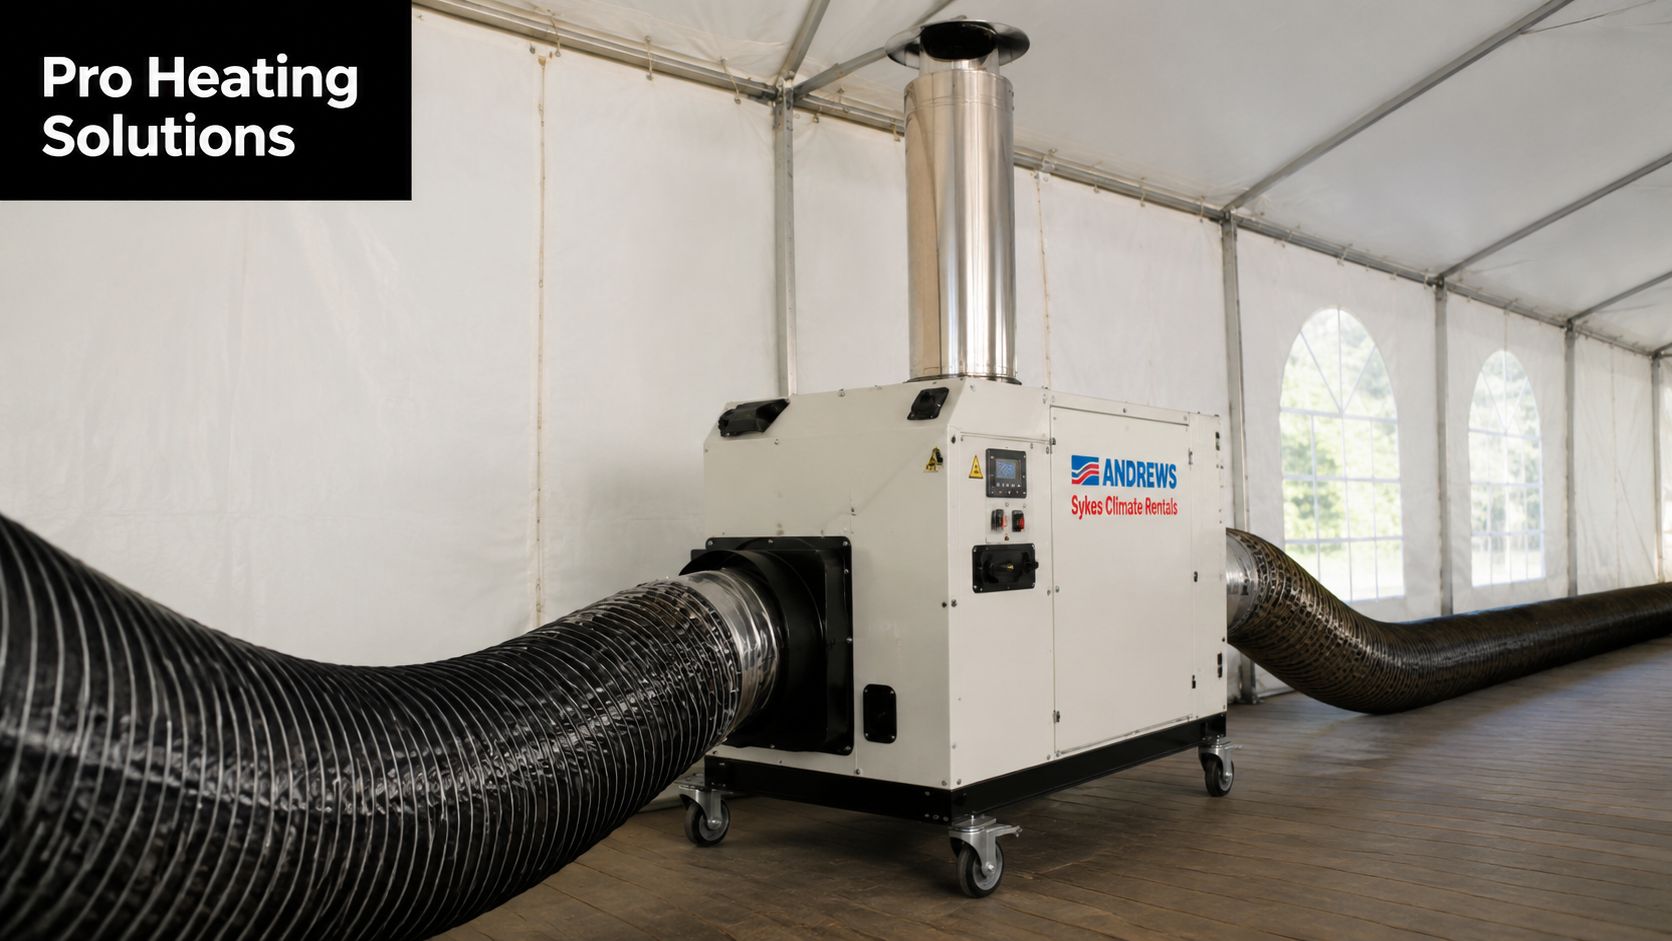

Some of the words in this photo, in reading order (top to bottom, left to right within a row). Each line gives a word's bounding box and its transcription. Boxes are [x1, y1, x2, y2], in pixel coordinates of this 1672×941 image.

[1102, 458, 1177, 489] ANDREWS
[1071, 494, 1103, 521] Sykes
[1105, 495, 1143, 516] Climate
[1145, 497, 1178, 516] Rentals
